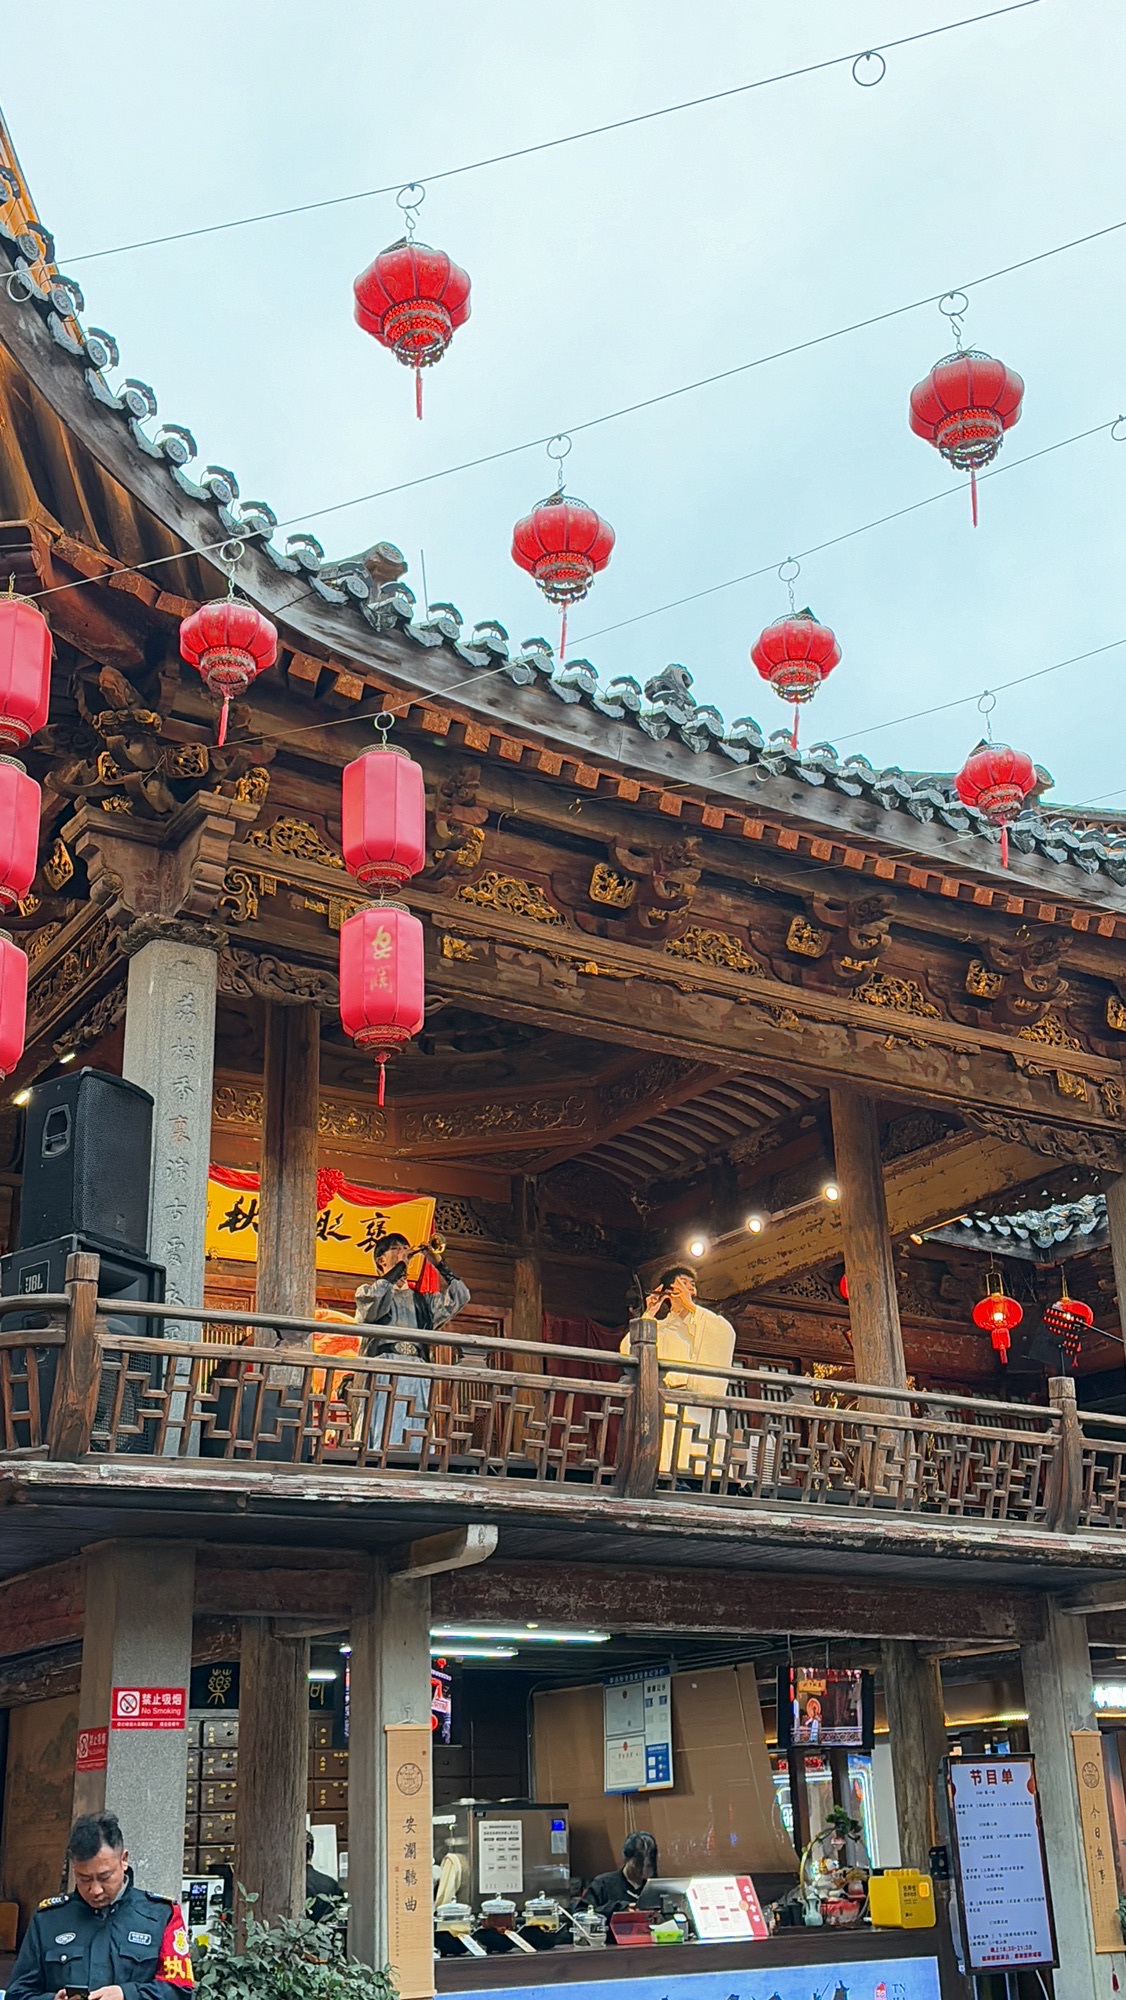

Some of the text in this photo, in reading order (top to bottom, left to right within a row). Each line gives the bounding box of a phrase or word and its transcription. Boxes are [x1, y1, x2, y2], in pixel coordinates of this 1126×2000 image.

[25, 1273, 43, 1293] JBL
[141, 1693, 182, 1706] 禁止吸烟
[152, 1707, 181, 1715] Smoking
[969, 1768, 1014, 1786] 节目单
